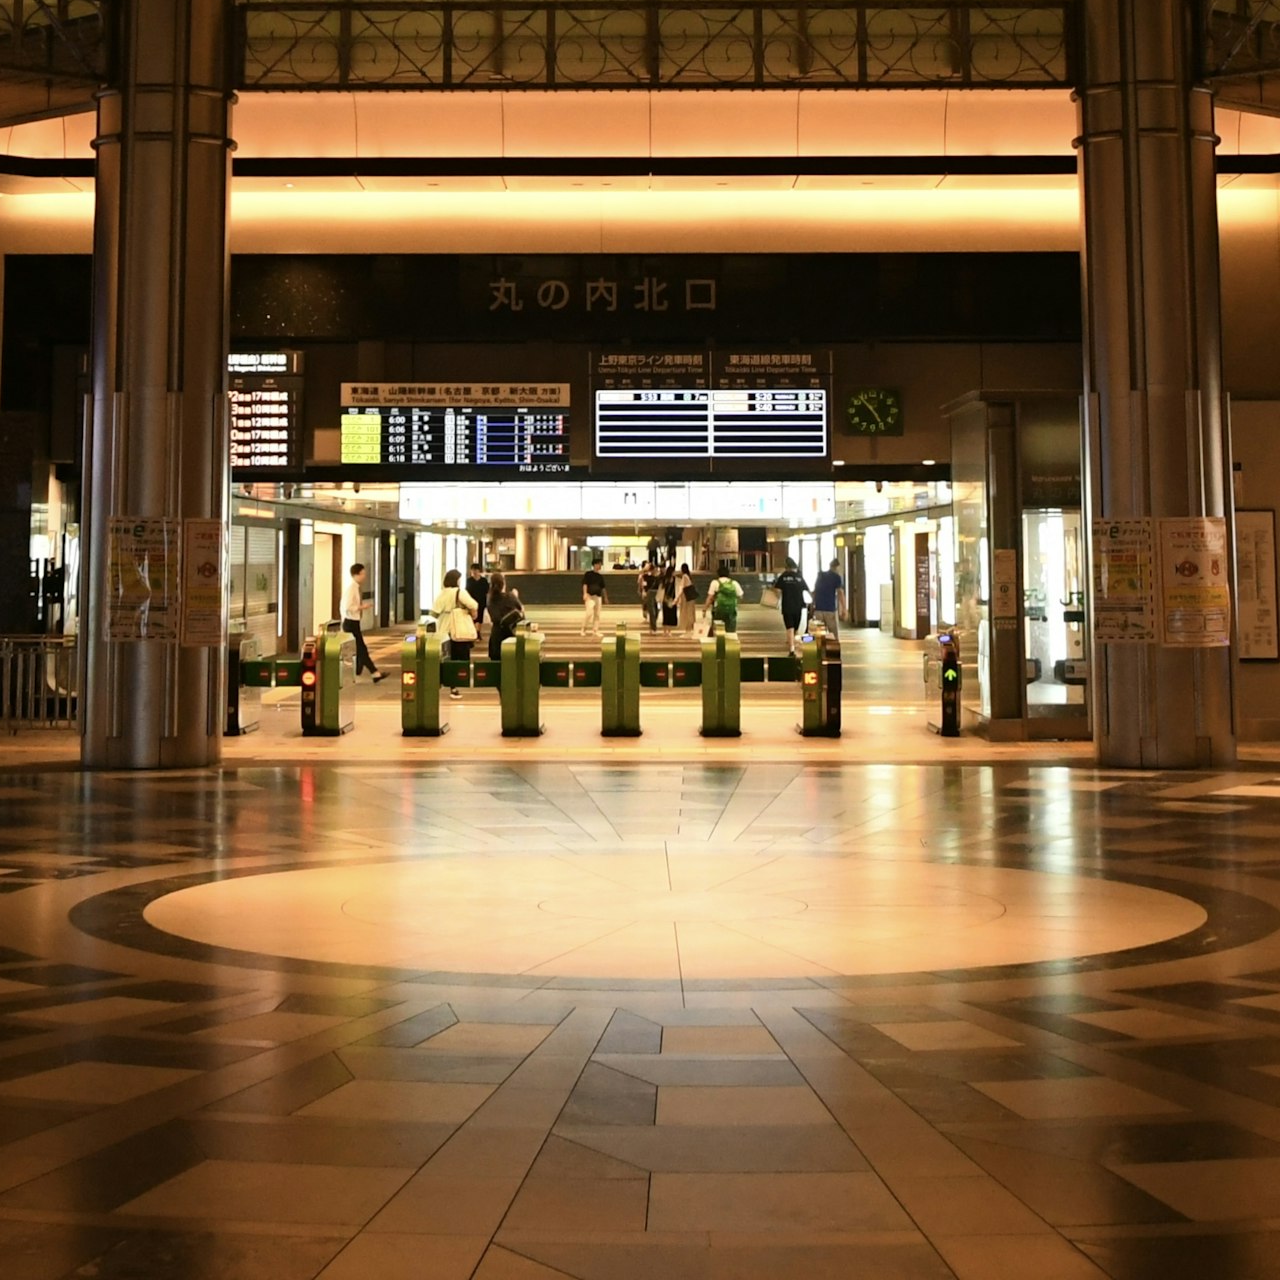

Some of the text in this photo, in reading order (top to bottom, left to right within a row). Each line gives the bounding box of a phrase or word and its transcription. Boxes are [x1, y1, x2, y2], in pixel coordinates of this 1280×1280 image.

[489, 277, 717, 312] 丸の内北口
[388, 416, 406, 424] 6:00
[388, 426, 406, 434] 6:06
[388, 435, 406, 443] 6:09
[388, 445, 406, 453] 6:15
[388, 455, 406, 463] 6:18
[402, 672, 415, 685] IC
[804, 672, 818, 685] IC
